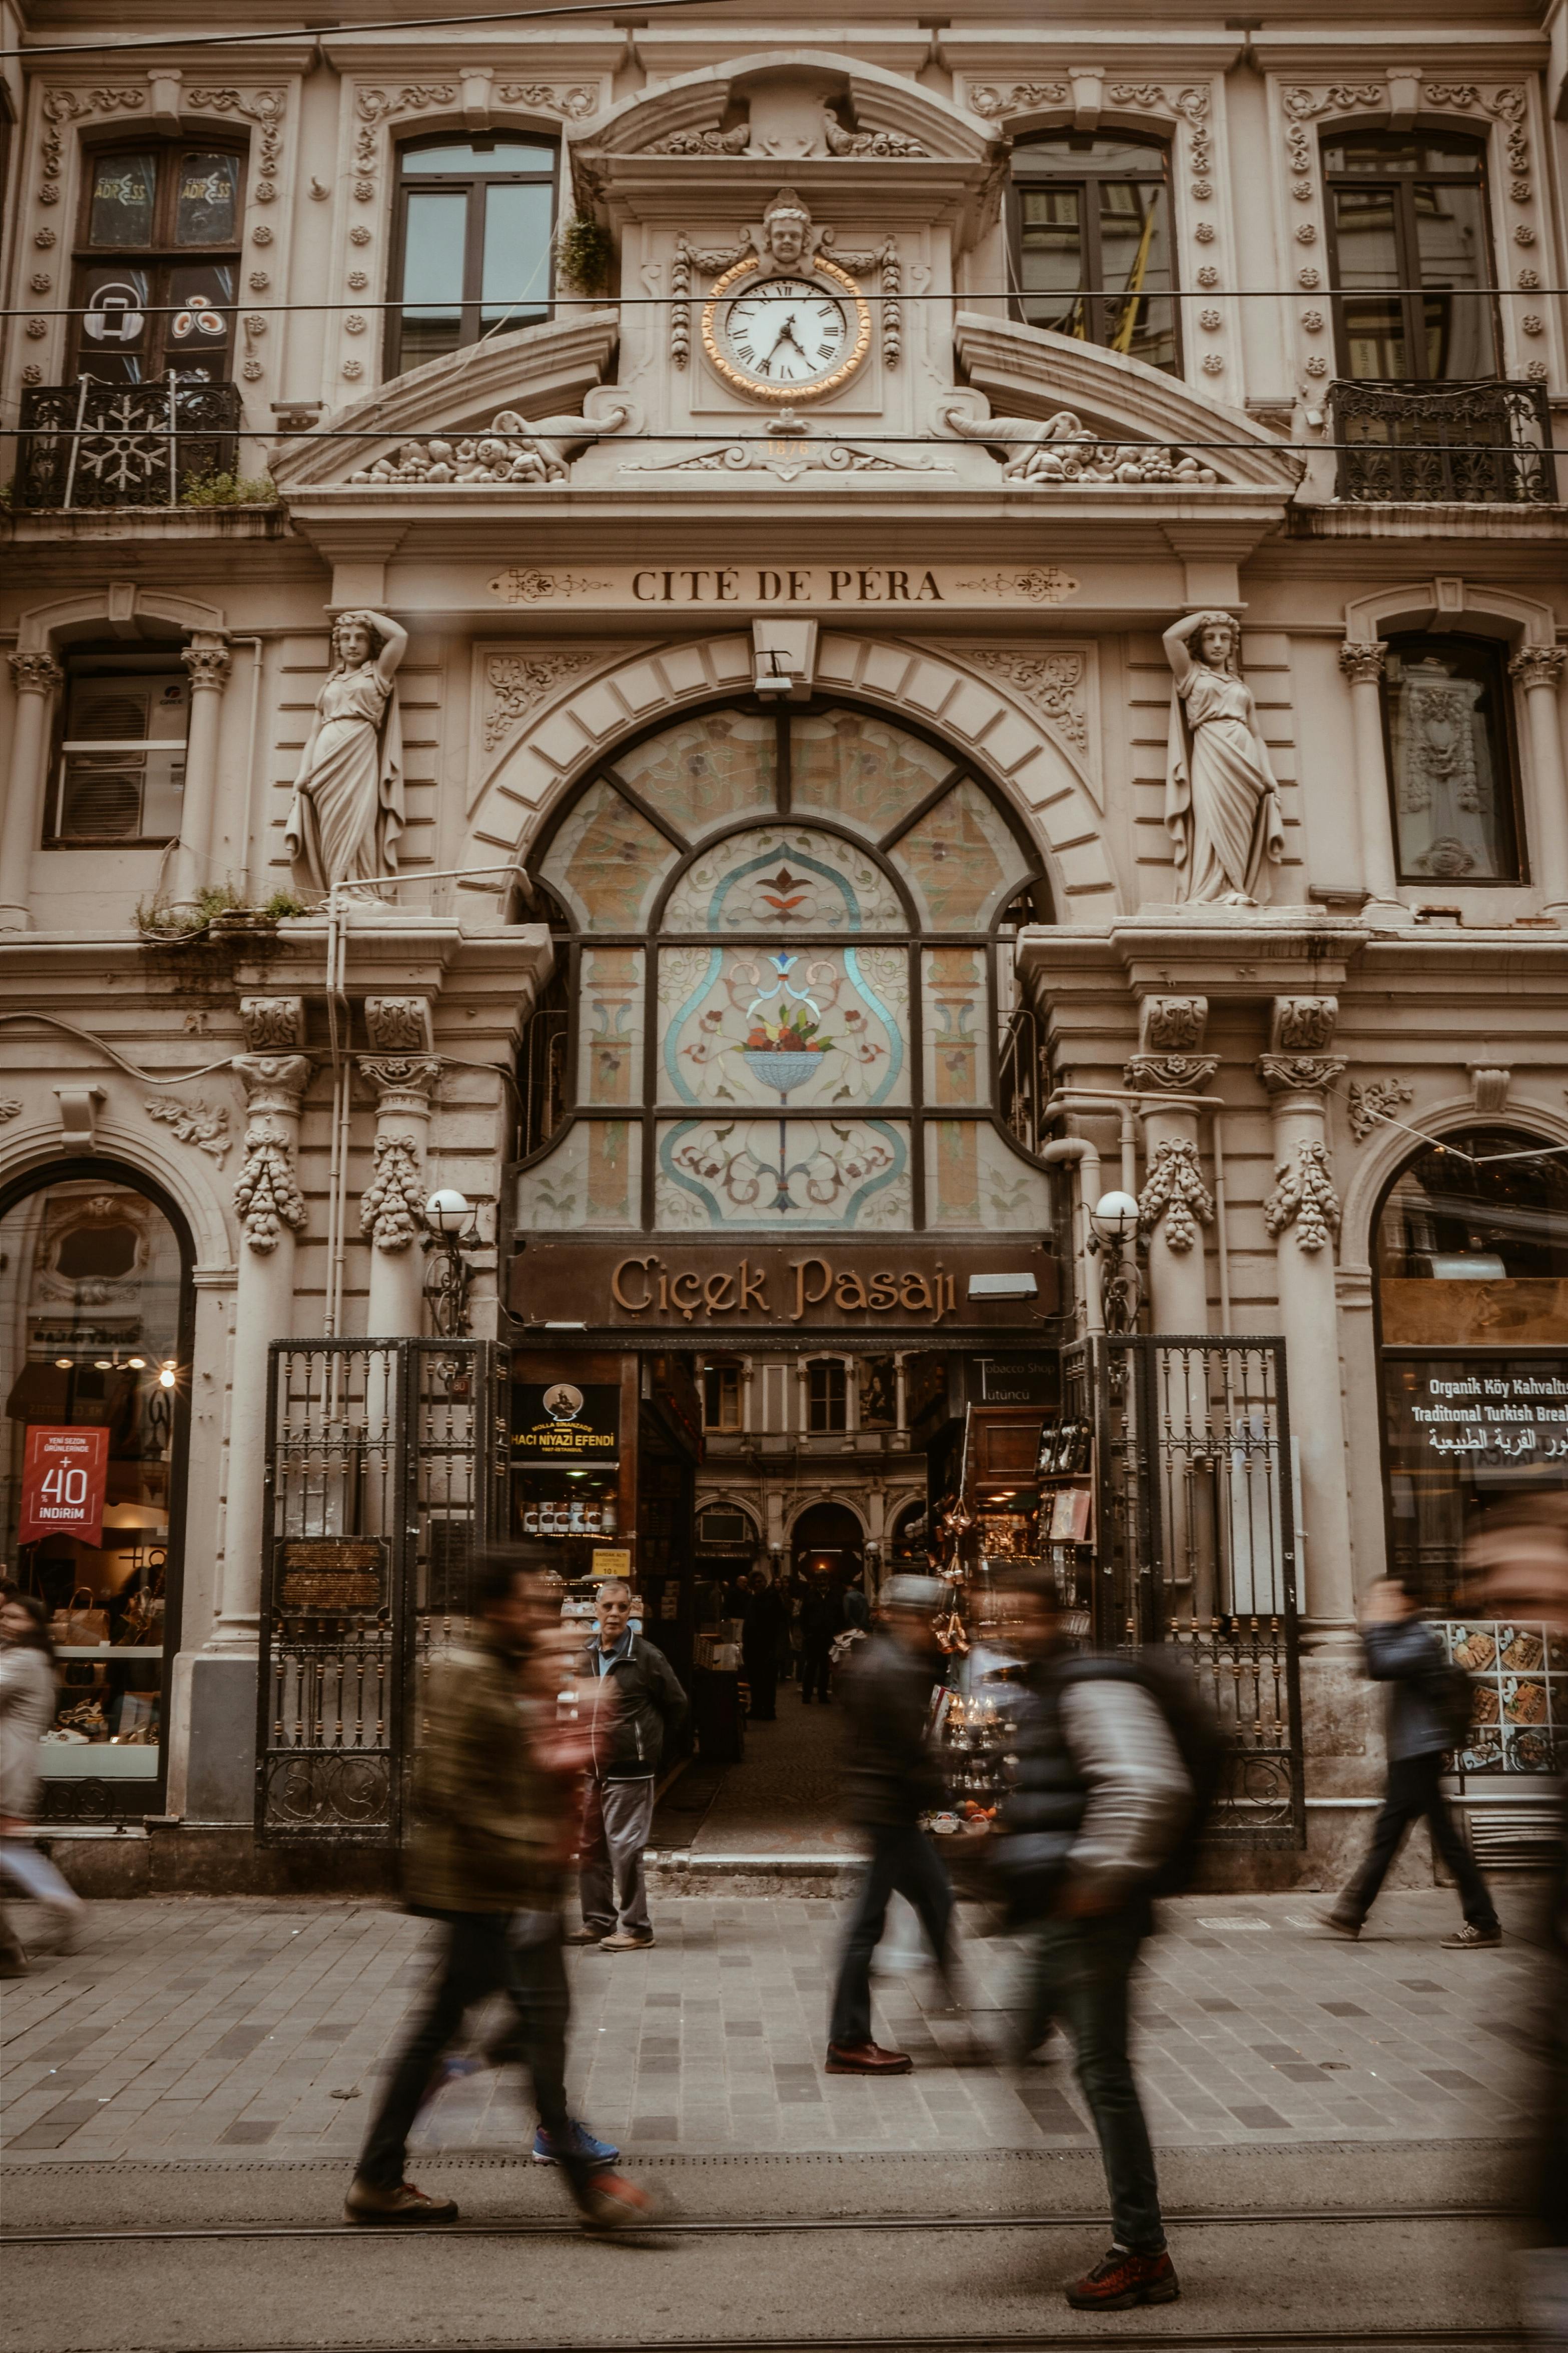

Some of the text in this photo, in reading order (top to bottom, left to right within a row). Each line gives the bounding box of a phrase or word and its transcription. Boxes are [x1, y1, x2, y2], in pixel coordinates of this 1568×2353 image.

[632, 566, 945, 601] CITÉ DE PÉRA
[1028, 1363, 1056, 1376] Shop
[1430, 1377, 1482, 1398] Organik
[1484, 1379, 1510, 1398] Köy
[1411, 1404, 1482, 1421] Traditional
[1484, 1404, 1534, 1421] Turkish
[532, 1422, 555, 1432] MOLLA
[511, 1431, 614, 1446] HACI NİYAZİ EFENDİ
[41, 1468, 88, 1504] 40
